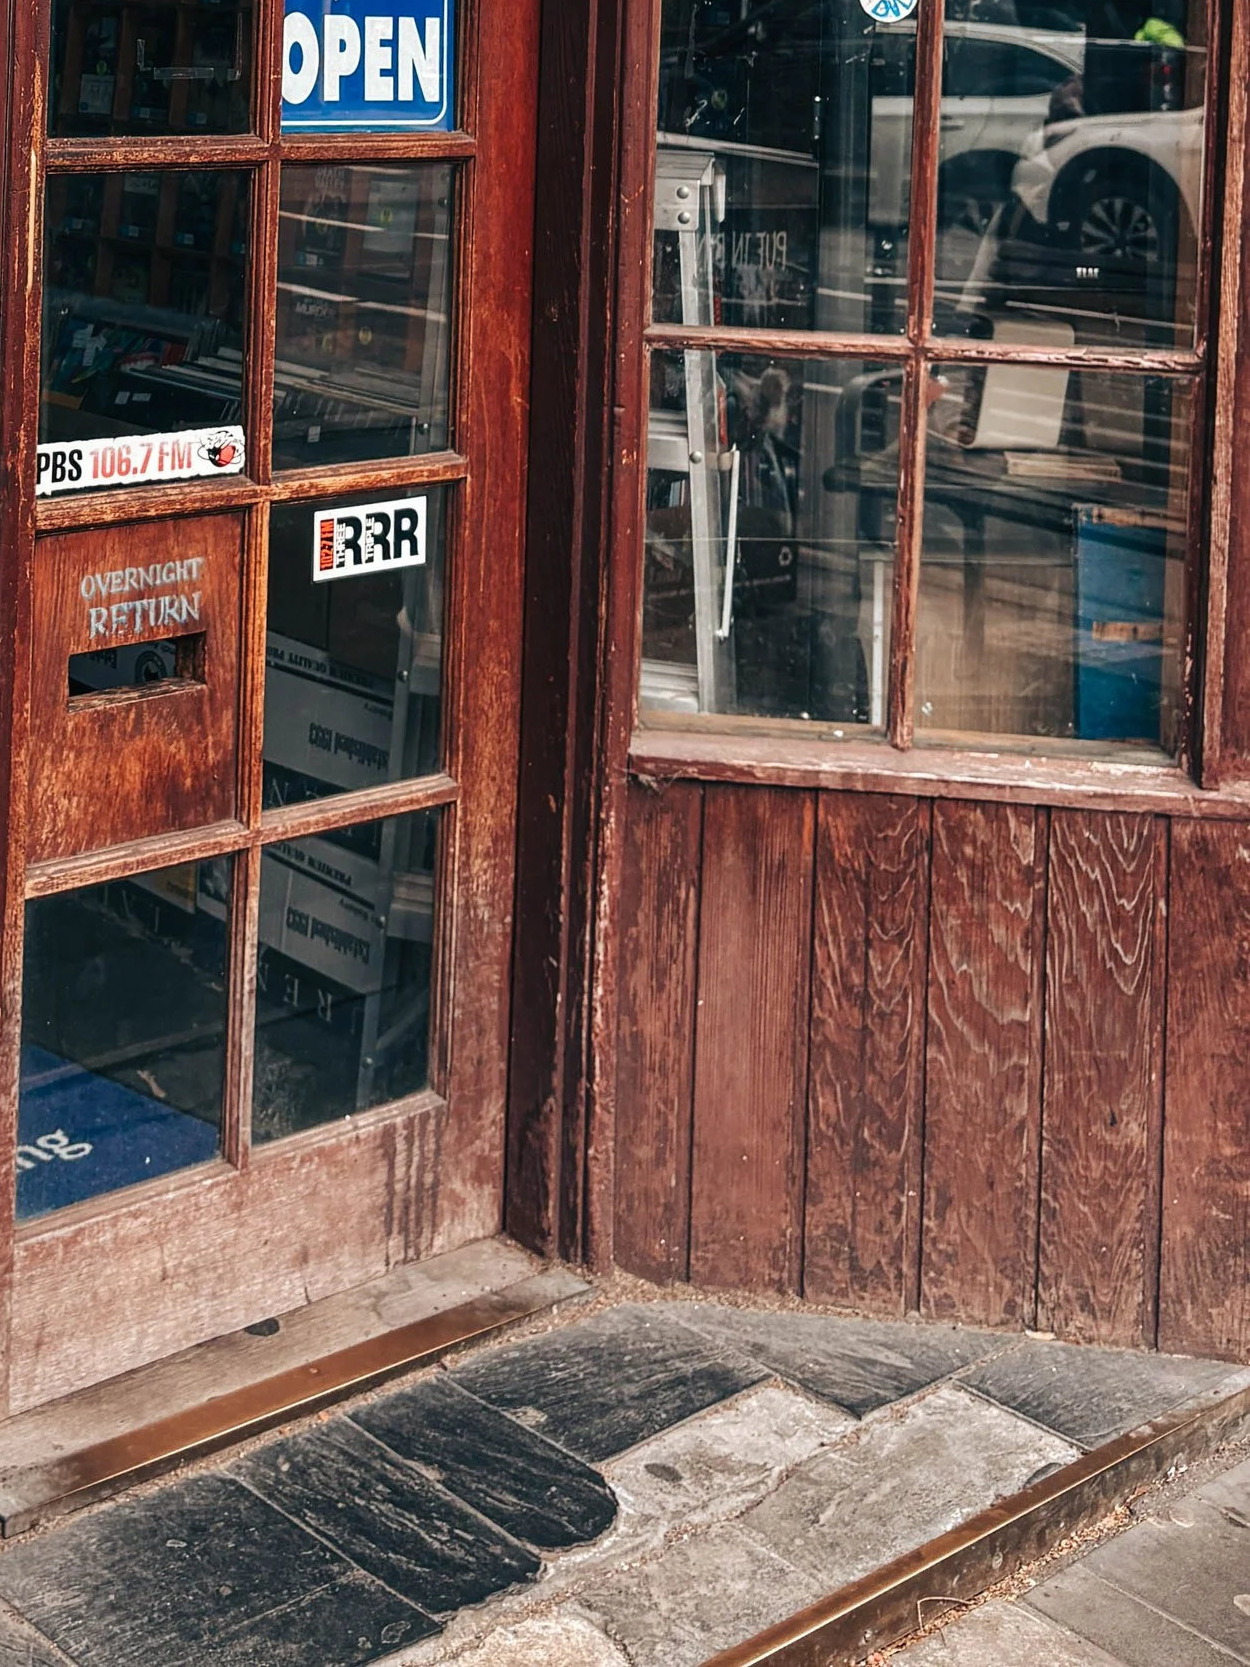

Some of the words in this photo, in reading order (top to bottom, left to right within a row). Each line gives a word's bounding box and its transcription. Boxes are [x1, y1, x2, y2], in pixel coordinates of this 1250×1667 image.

[282, 12, 441, 105] OPEN
[37, 449, 83, 485] PBS
[90, 441, 152, 479] 106.7
[158, 441, 192, 472] FM
[336, 508, 418, 568] RRR
[81, 557, 205, 601] OVERNIGHT
[89, 592, 201, 639] RETURN
